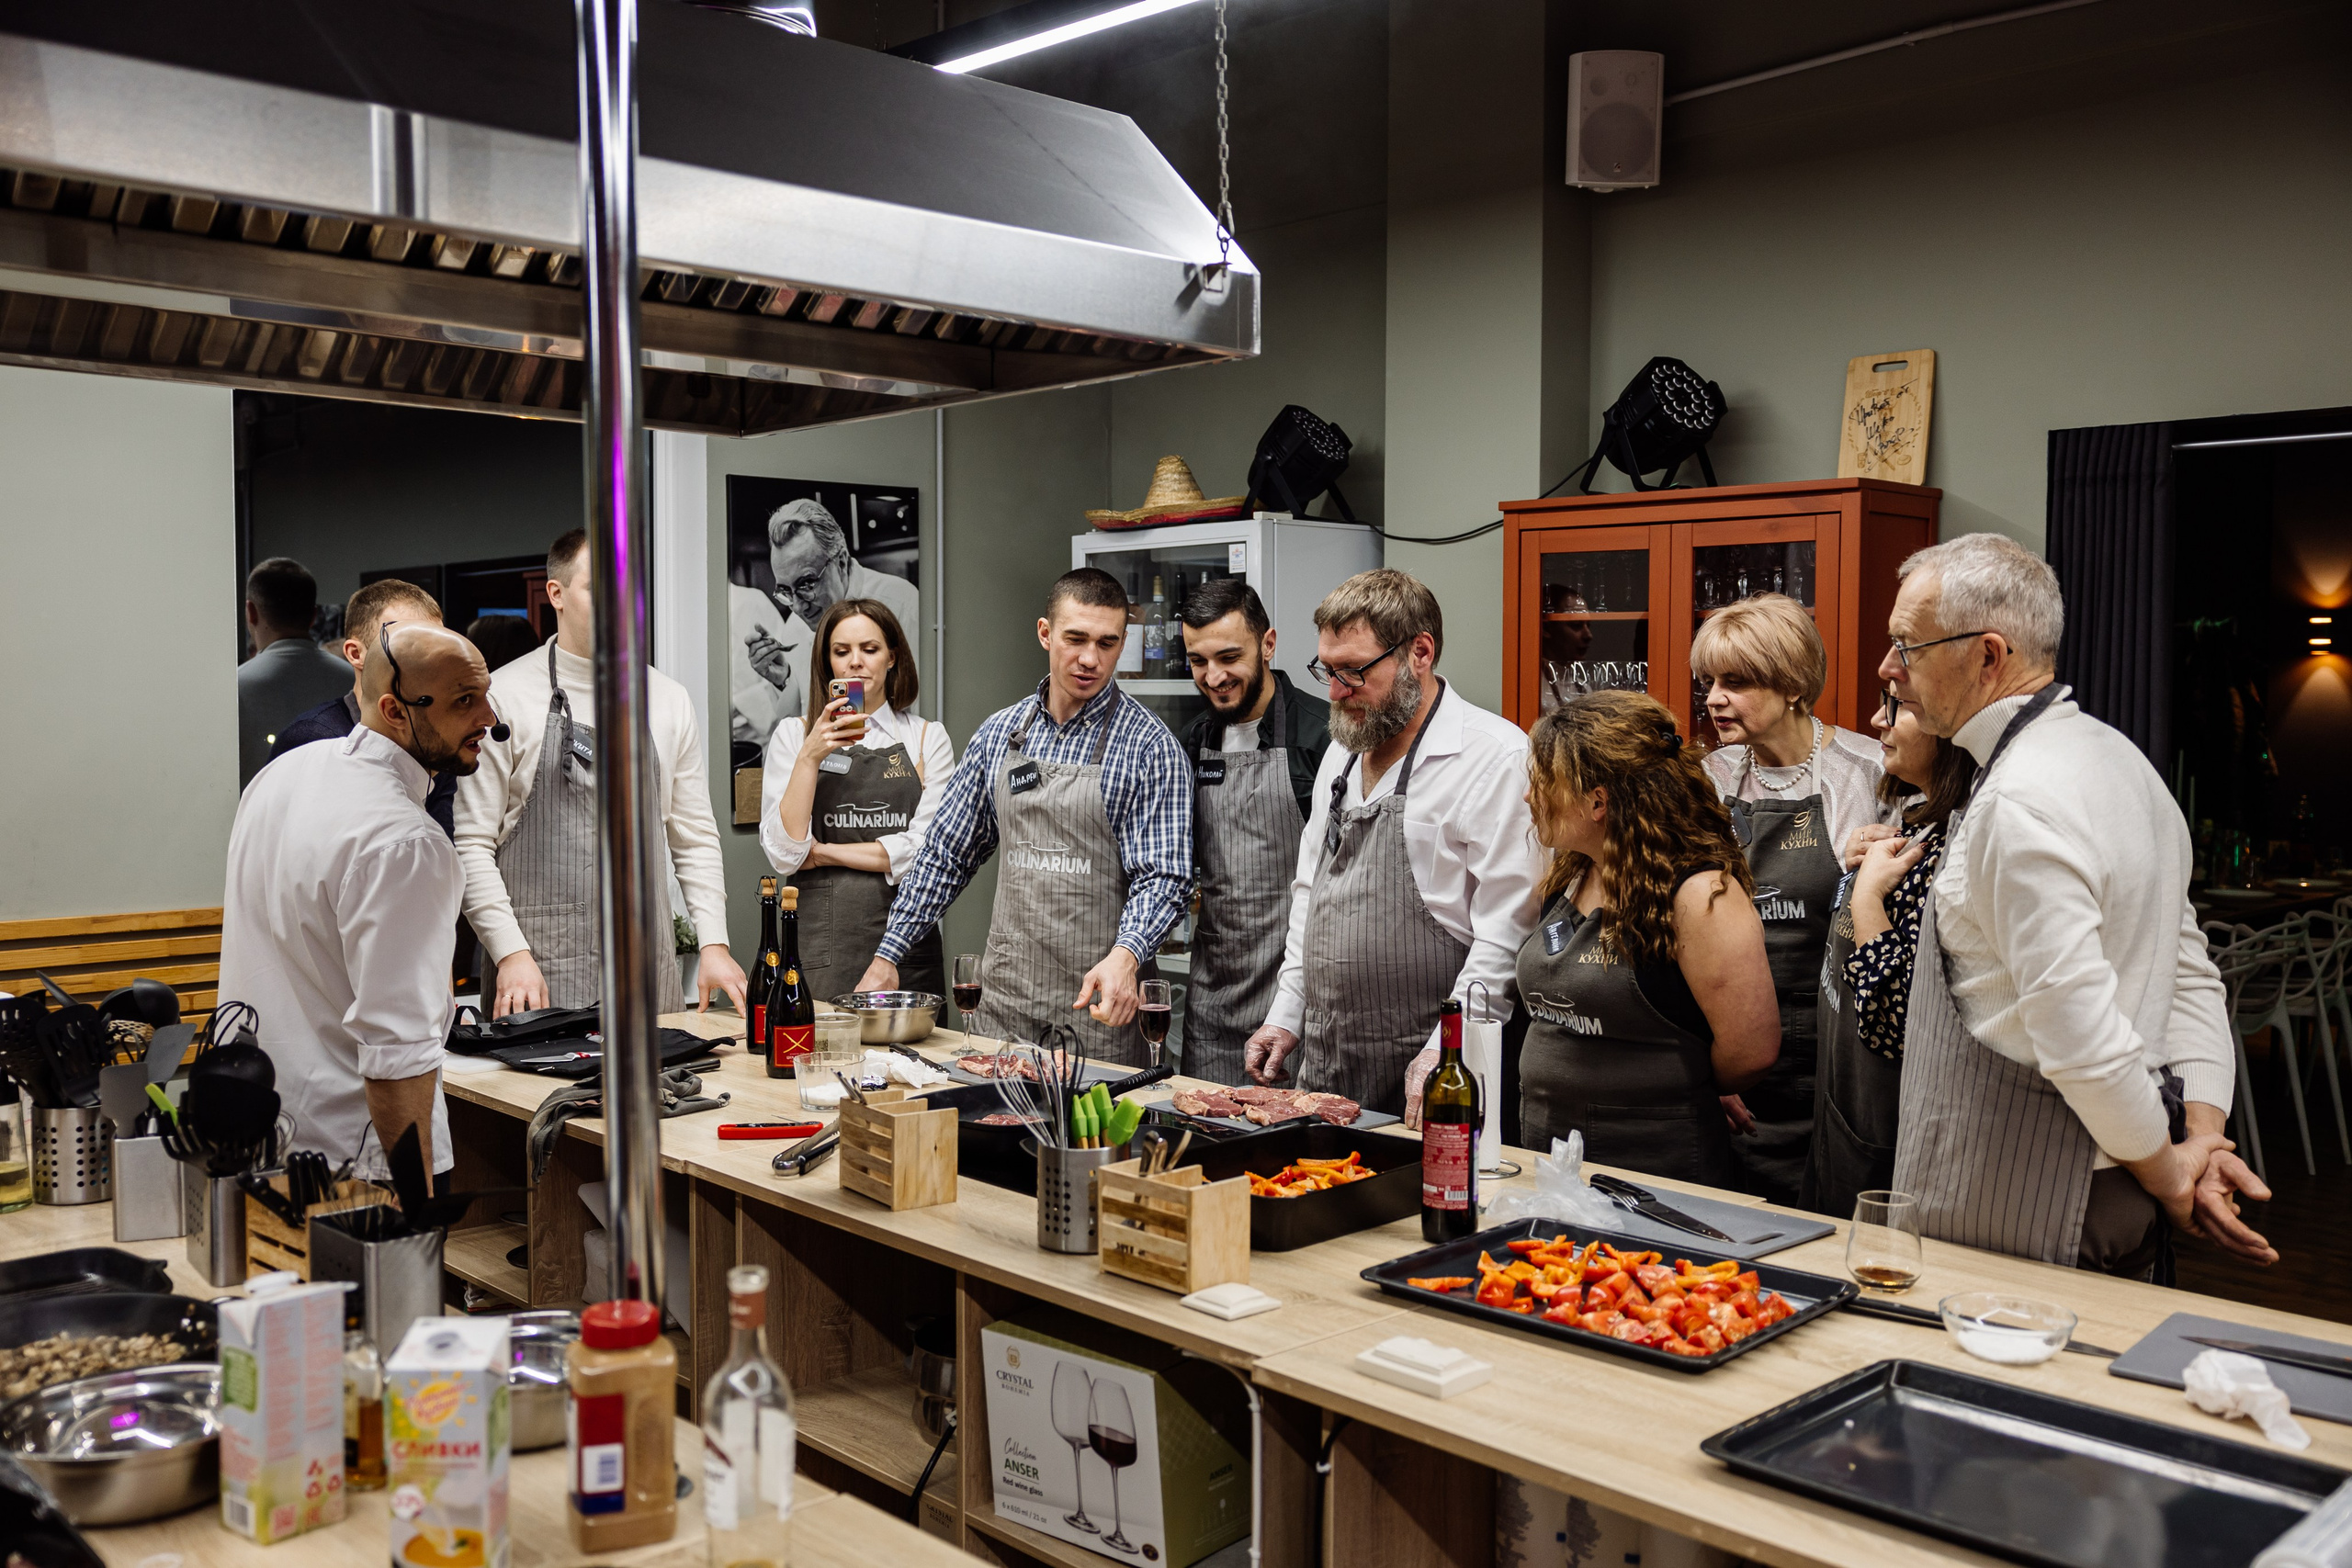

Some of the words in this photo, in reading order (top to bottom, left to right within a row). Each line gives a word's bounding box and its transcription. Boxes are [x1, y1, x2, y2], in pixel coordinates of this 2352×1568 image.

[1780, 837, 1818, 851] КУХНИ
[1789, 829, 1812, 840] МИР
[996, 1370, 1034, 1389] CRYSTAL
[1004, 1438, 1036, 1461] Collection
[1004, 1458, 1039, 1480] ANSER
[1002, 1476, 1013, 1486] Red
[1014, 1480, 1028, 1491] wine
[1029, 1485, 1044, 1496] glass
